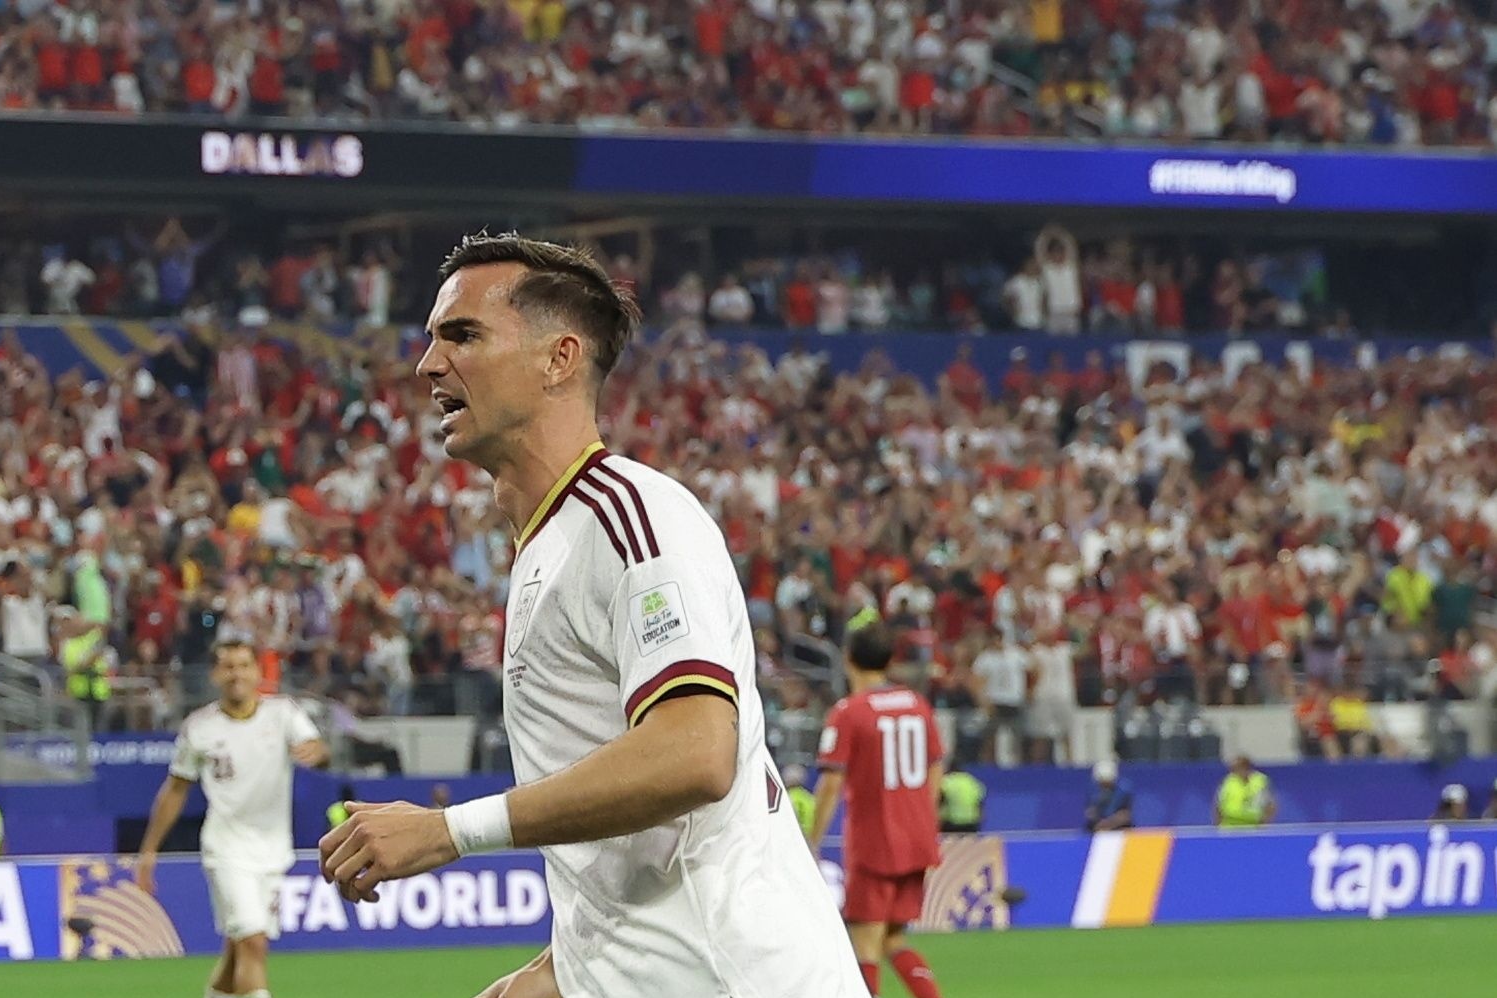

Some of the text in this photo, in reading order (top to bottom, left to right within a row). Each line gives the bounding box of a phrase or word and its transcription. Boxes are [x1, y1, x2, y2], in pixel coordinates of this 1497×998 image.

[201, 130, 365, 178] DALLAS
[642, 617, 681, 645] EDUCATION
[876, 714, 929, 791] 10
[279, 869, 549, 933] FA WORLD
[1308, 823, 1485, 920] tap in
